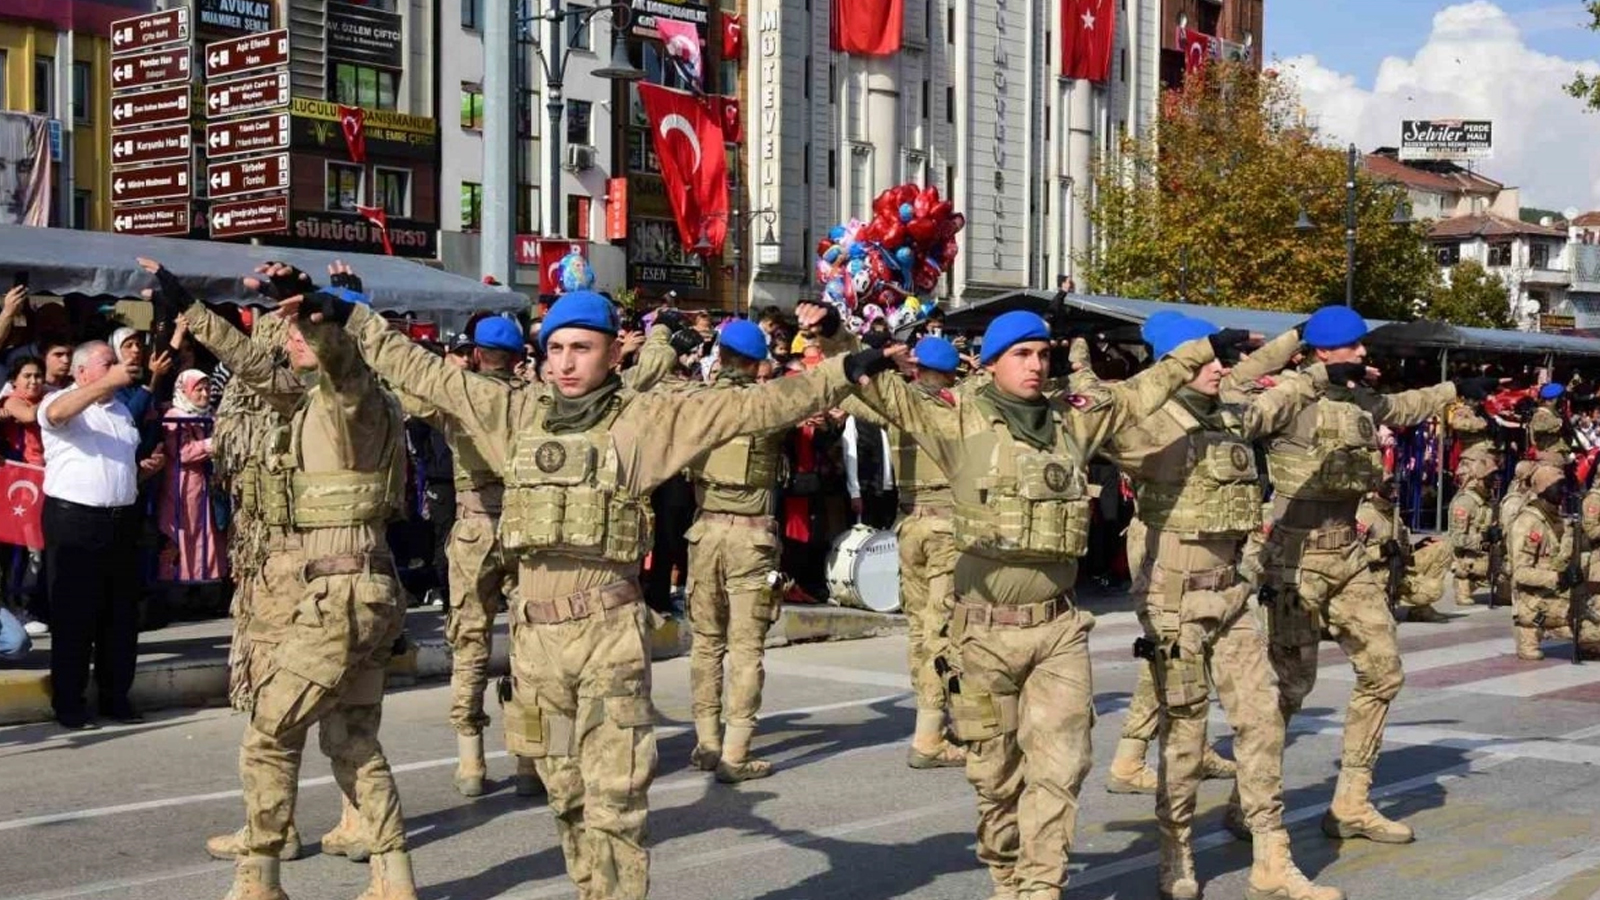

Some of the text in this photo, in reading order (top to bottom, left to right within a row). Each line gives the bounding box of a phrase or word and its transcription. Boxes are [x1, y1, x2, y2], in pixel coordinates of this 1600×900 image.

[219, 0, 269, 18] AVUKAT
[1404, 121, 1489, 142] Selviler PERDE
[295, 217, 367, 241] SÜRÜCÜ
[642, 266, 667, 281] ESEN
